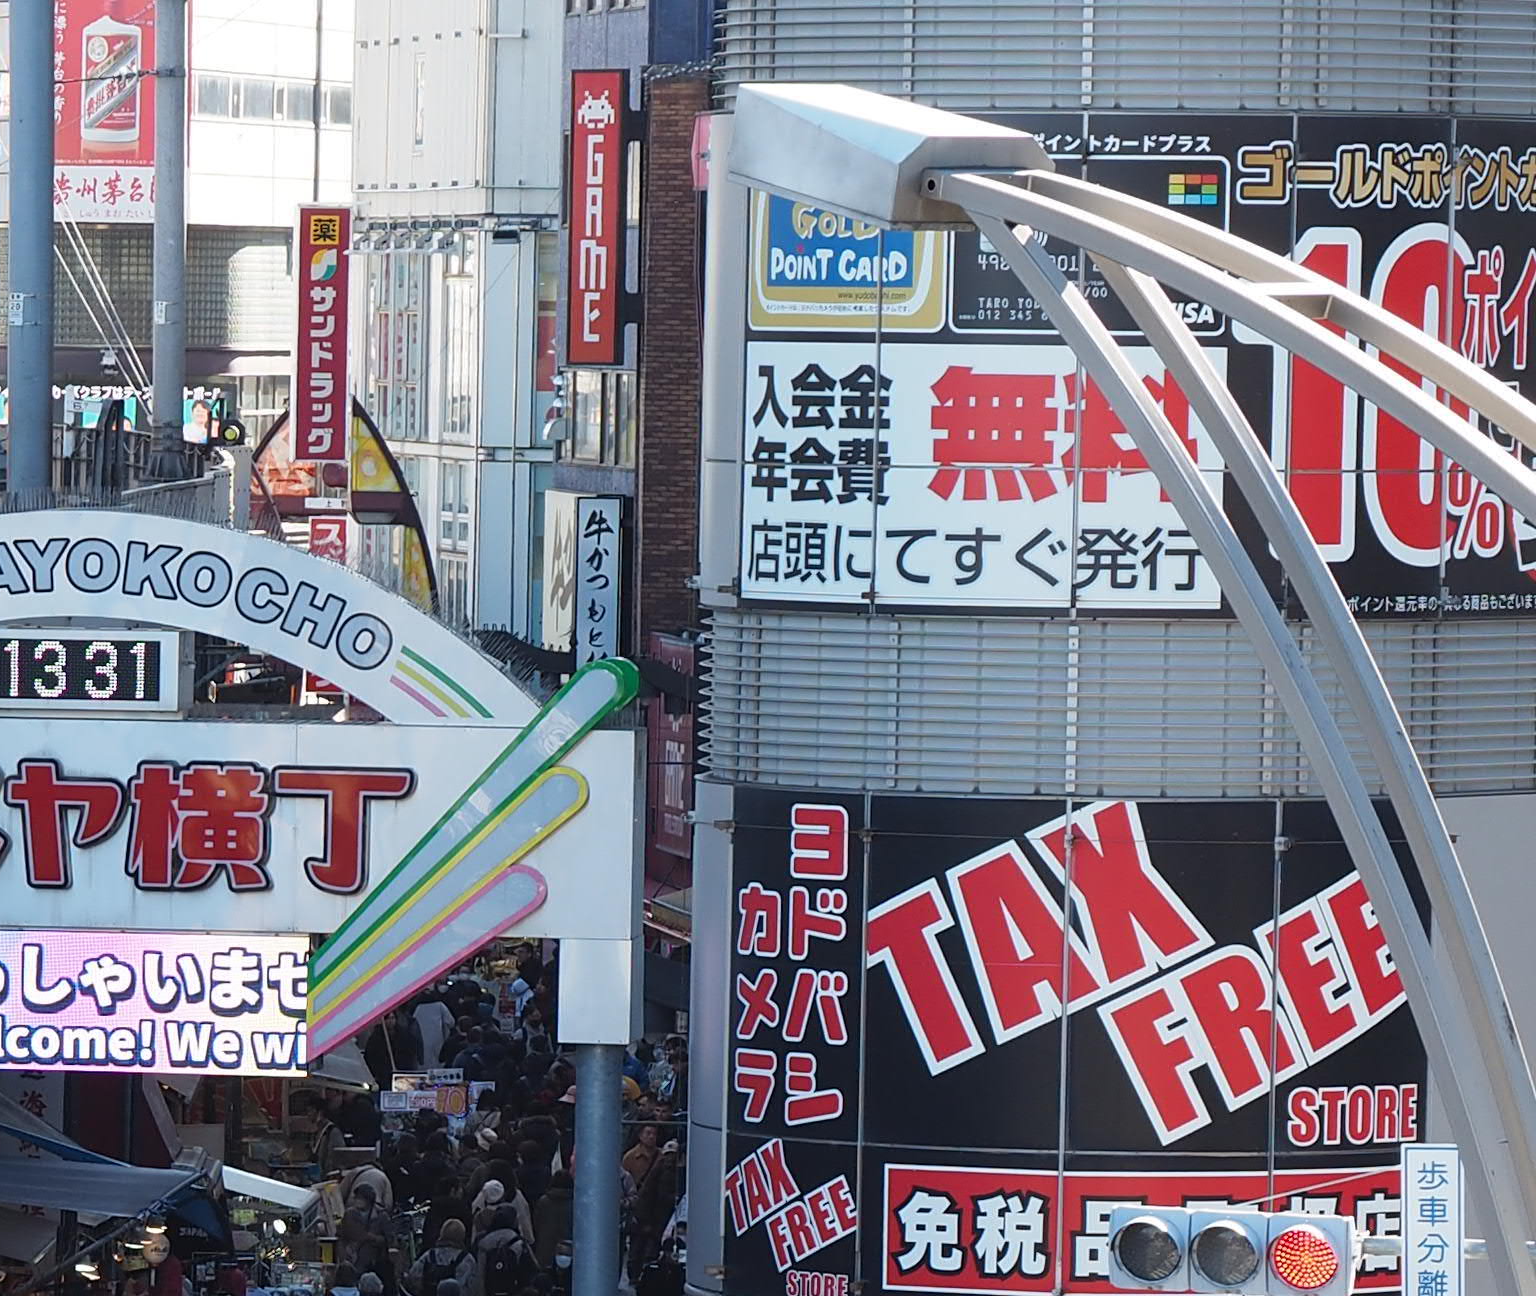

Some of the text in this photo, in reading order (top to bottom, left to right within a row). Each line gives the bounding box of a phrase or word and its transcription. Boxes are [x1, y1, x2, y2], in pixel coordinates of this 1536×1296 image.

[310, 214, 340, 243] 薬
[578, 133, 607, 345] GAME
[307, 284, 336, 457] サンドラッグ
[751, 364, 892, 430] 入会金
[750, 435, 891, 506] 年会費
[746, 520, 1200, 592] 店頭にてすぐ発行
[733, 803, 850, 1126] ヨドバシ カメラ
[868, 799, 1216, 1077] TAX
[1286, 1083, 1418, 1148] STORE
[723, 1137, 801, 1238] TAX
[766, 1174, 860, 1274] FREE
